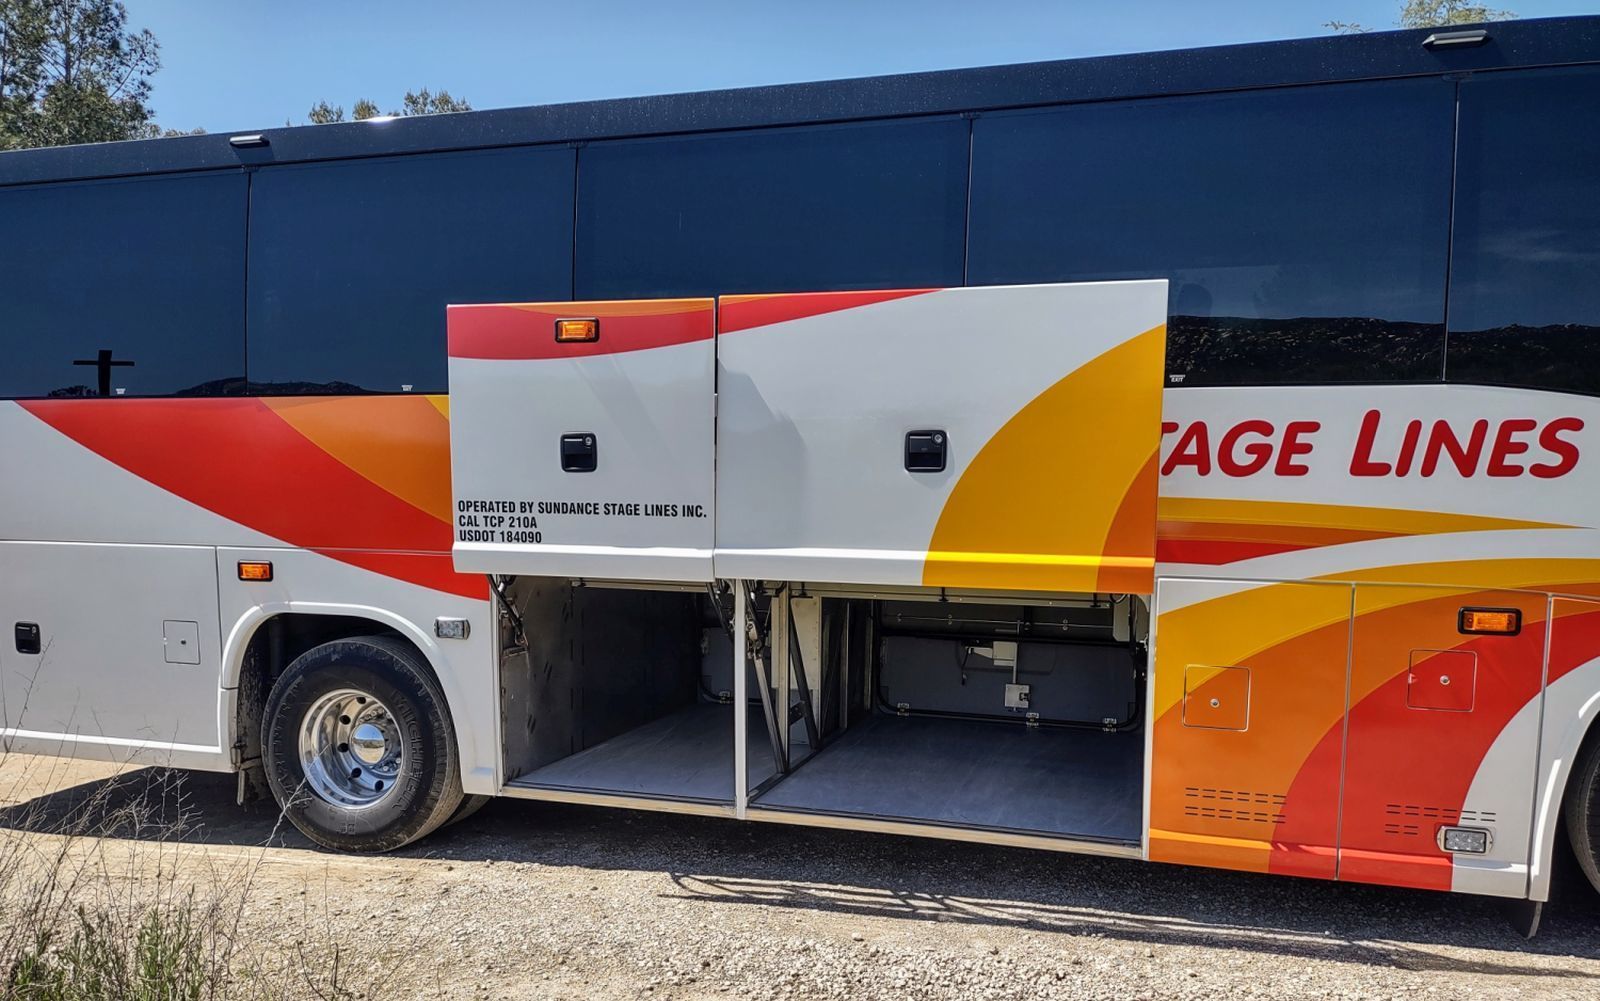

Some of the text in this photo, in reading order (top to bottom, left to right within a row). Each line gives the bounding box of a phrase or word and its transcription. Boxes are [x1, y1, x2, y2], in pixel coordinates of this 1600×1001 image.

[1349, 409, 1585, 479] LINES
[458, 500, 707, 518] OPERATED BY SUNDANCE STAGE LINES INC.
[458, 515, 538, 529] CAL TCP 210A
[459, 530, 542, 544] USDOT 184090
